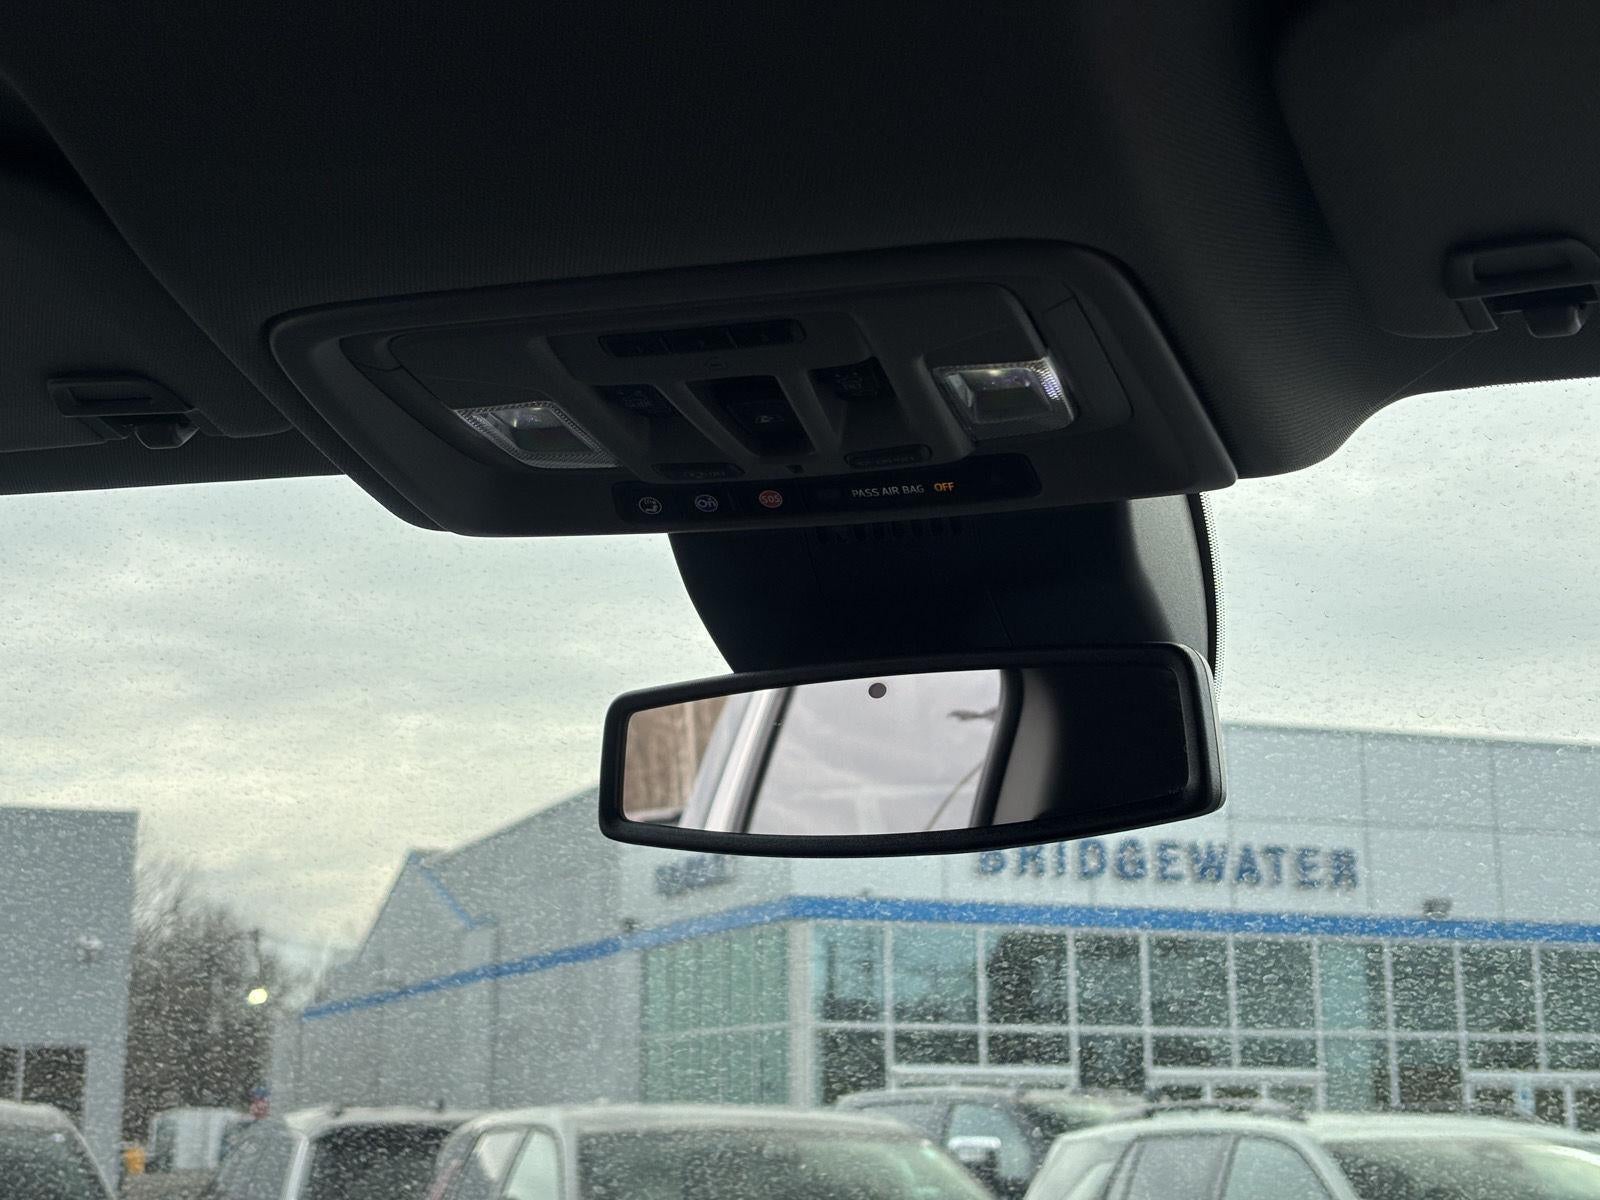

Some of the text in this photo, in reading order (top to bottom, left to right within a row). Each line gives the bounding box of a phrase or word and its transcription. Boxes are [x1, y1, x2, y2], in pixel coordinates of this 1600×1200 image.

[851, 481, 956, 498] PASS AIR BAG OFF
[761, 494, 780, 504] SOS
